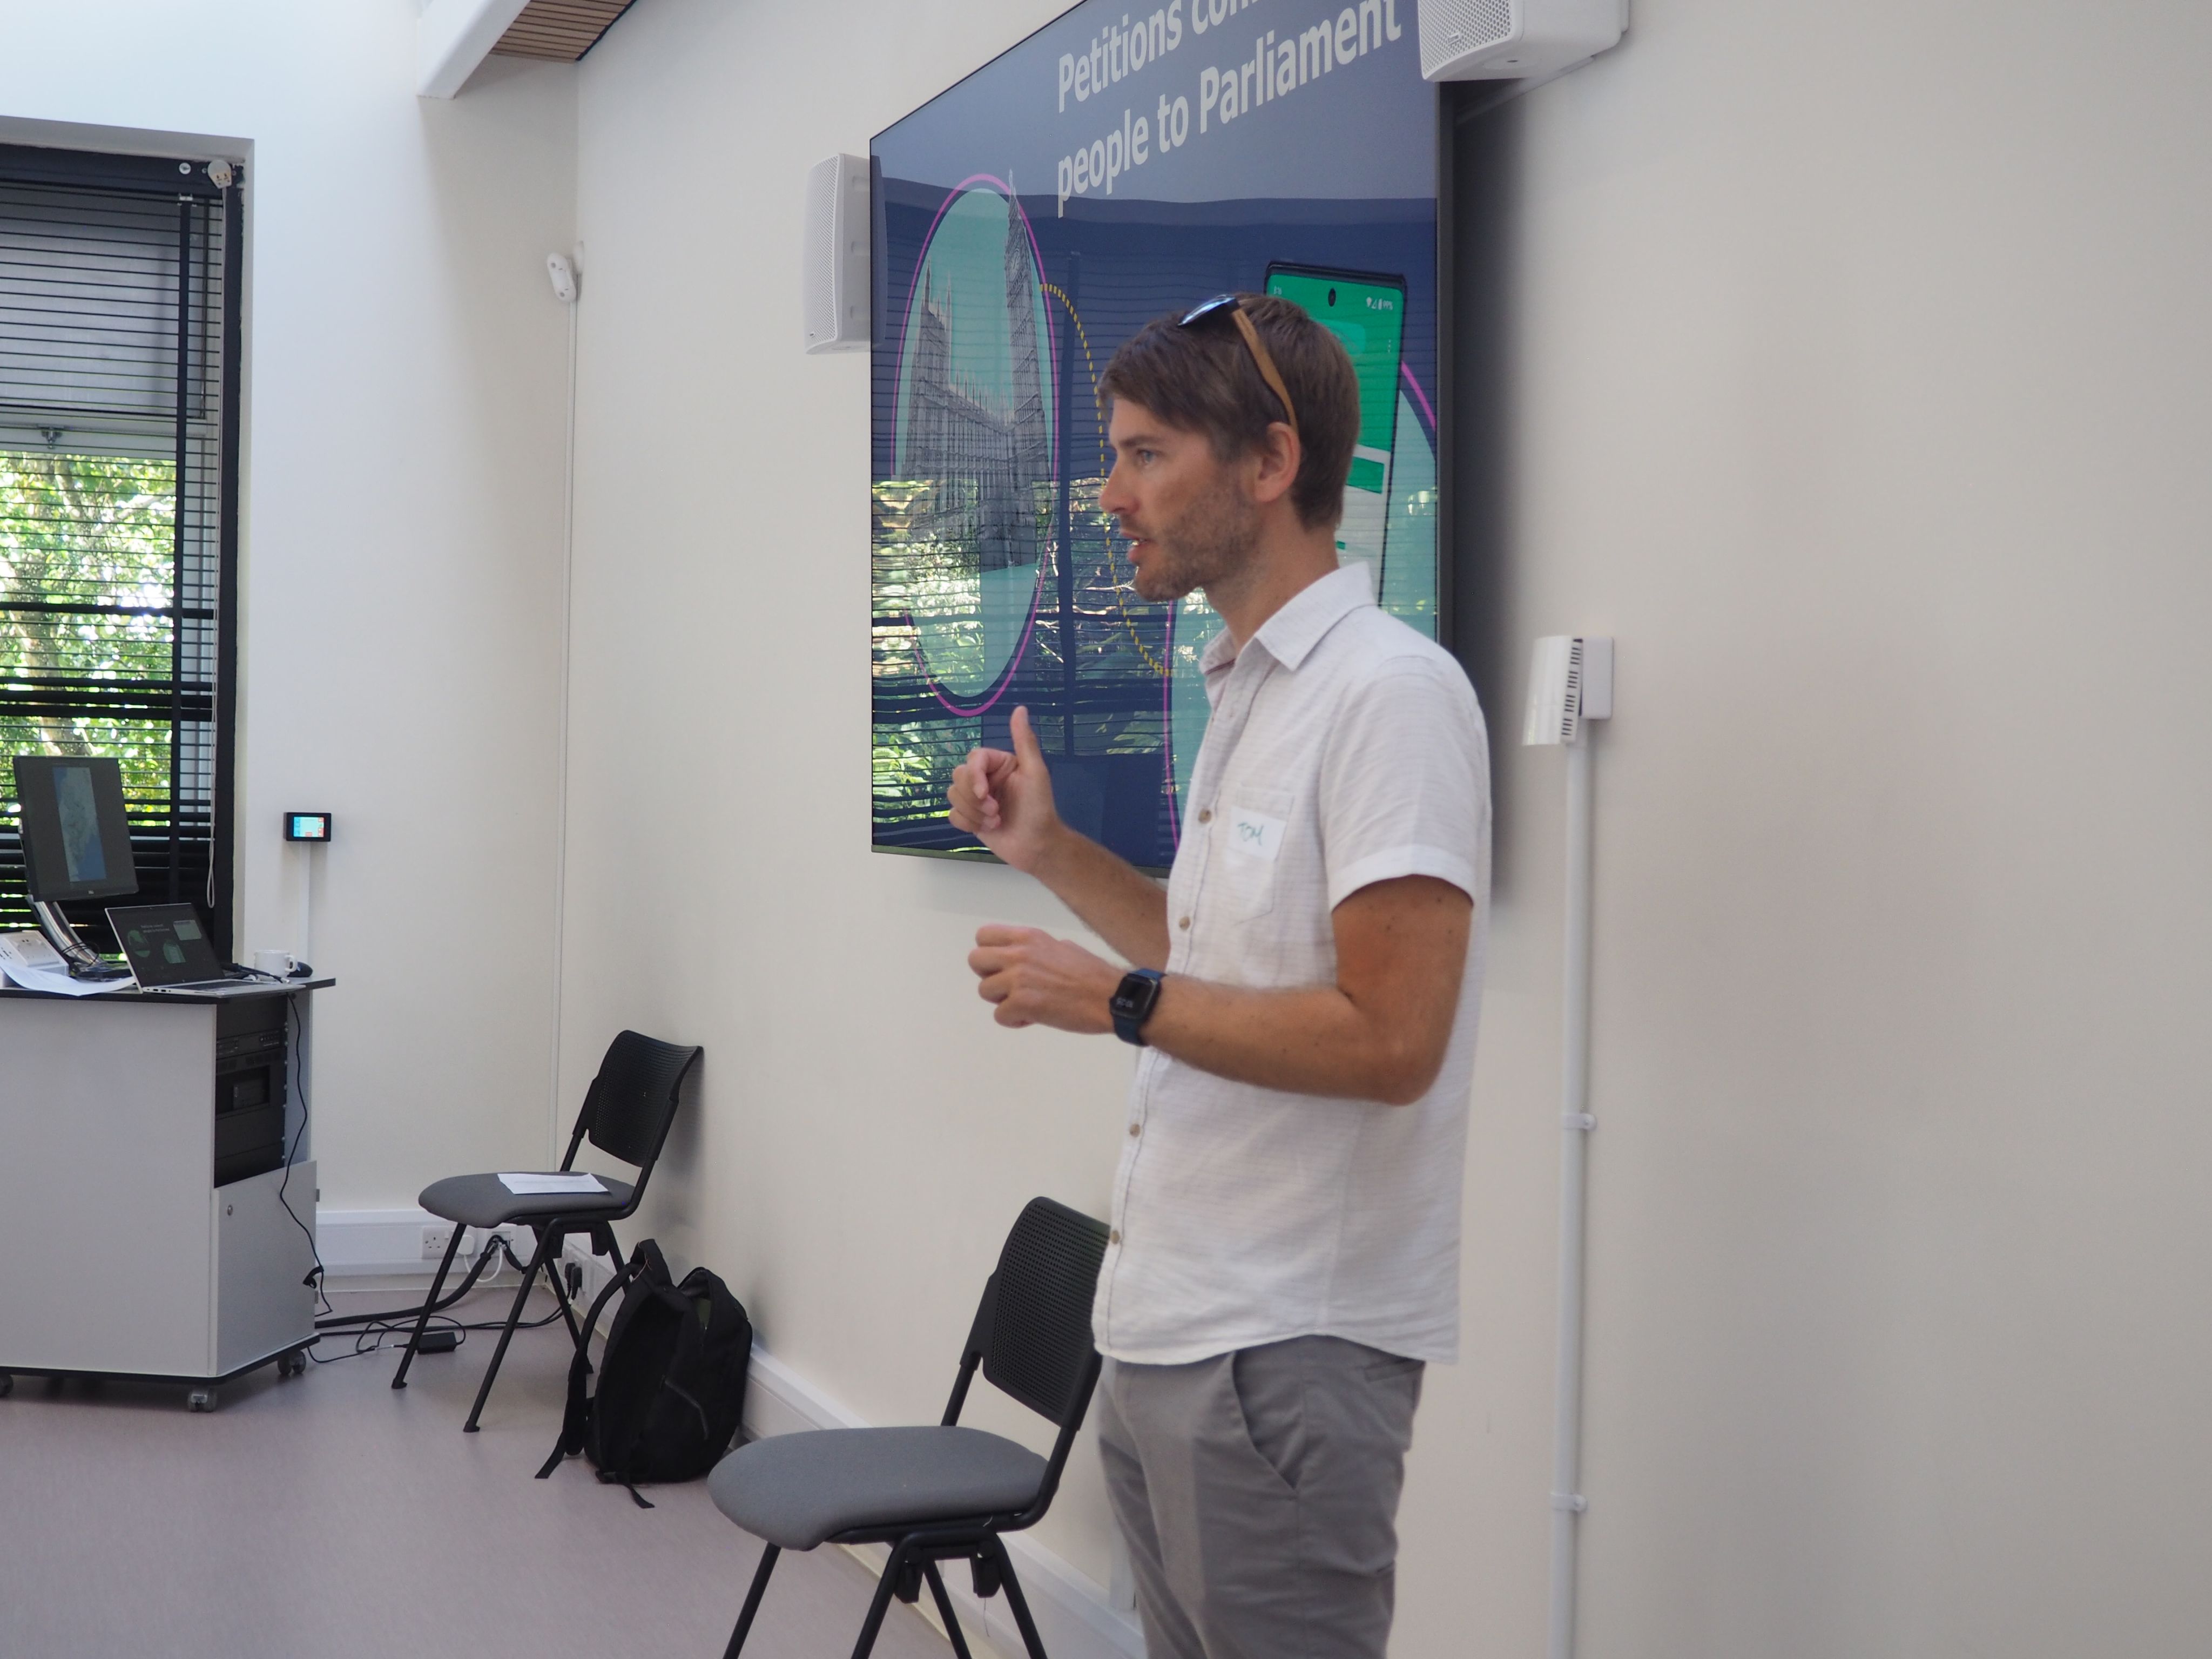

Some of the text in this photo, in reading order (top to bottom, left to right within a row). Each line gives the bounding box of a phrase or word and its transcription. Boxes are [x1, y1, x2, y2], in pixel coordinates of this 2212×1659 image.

[1058, 0, 1401, 218] people to Parliament
[1059, 0, 1182, 113] Petitions
